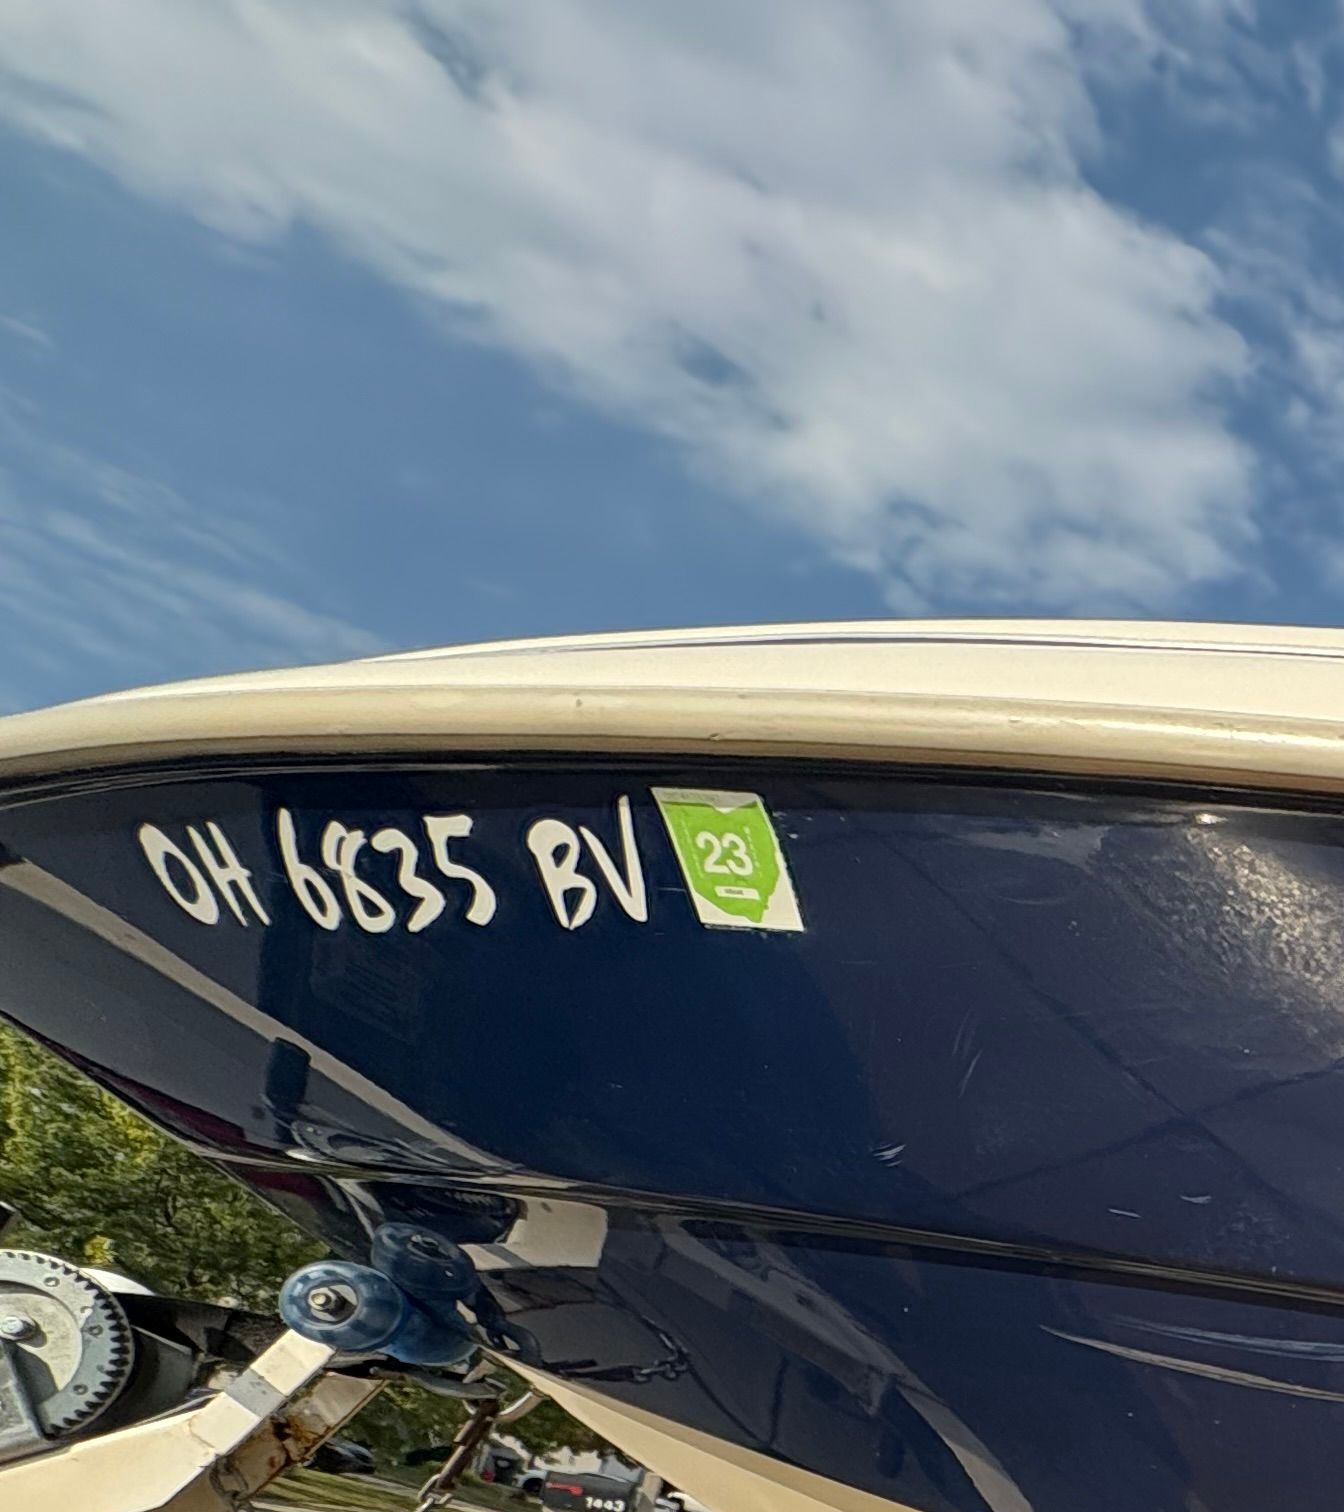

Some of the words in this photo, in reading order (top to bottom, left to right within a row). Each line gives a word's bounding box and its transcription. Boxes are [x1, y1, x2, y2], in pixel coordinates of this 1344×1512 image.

[138, 821, 272, 928] OH
[278, 807, 497, 933] 6835
[526, 794, 649, 930] BV
[695, 831, 754, 877] 23
